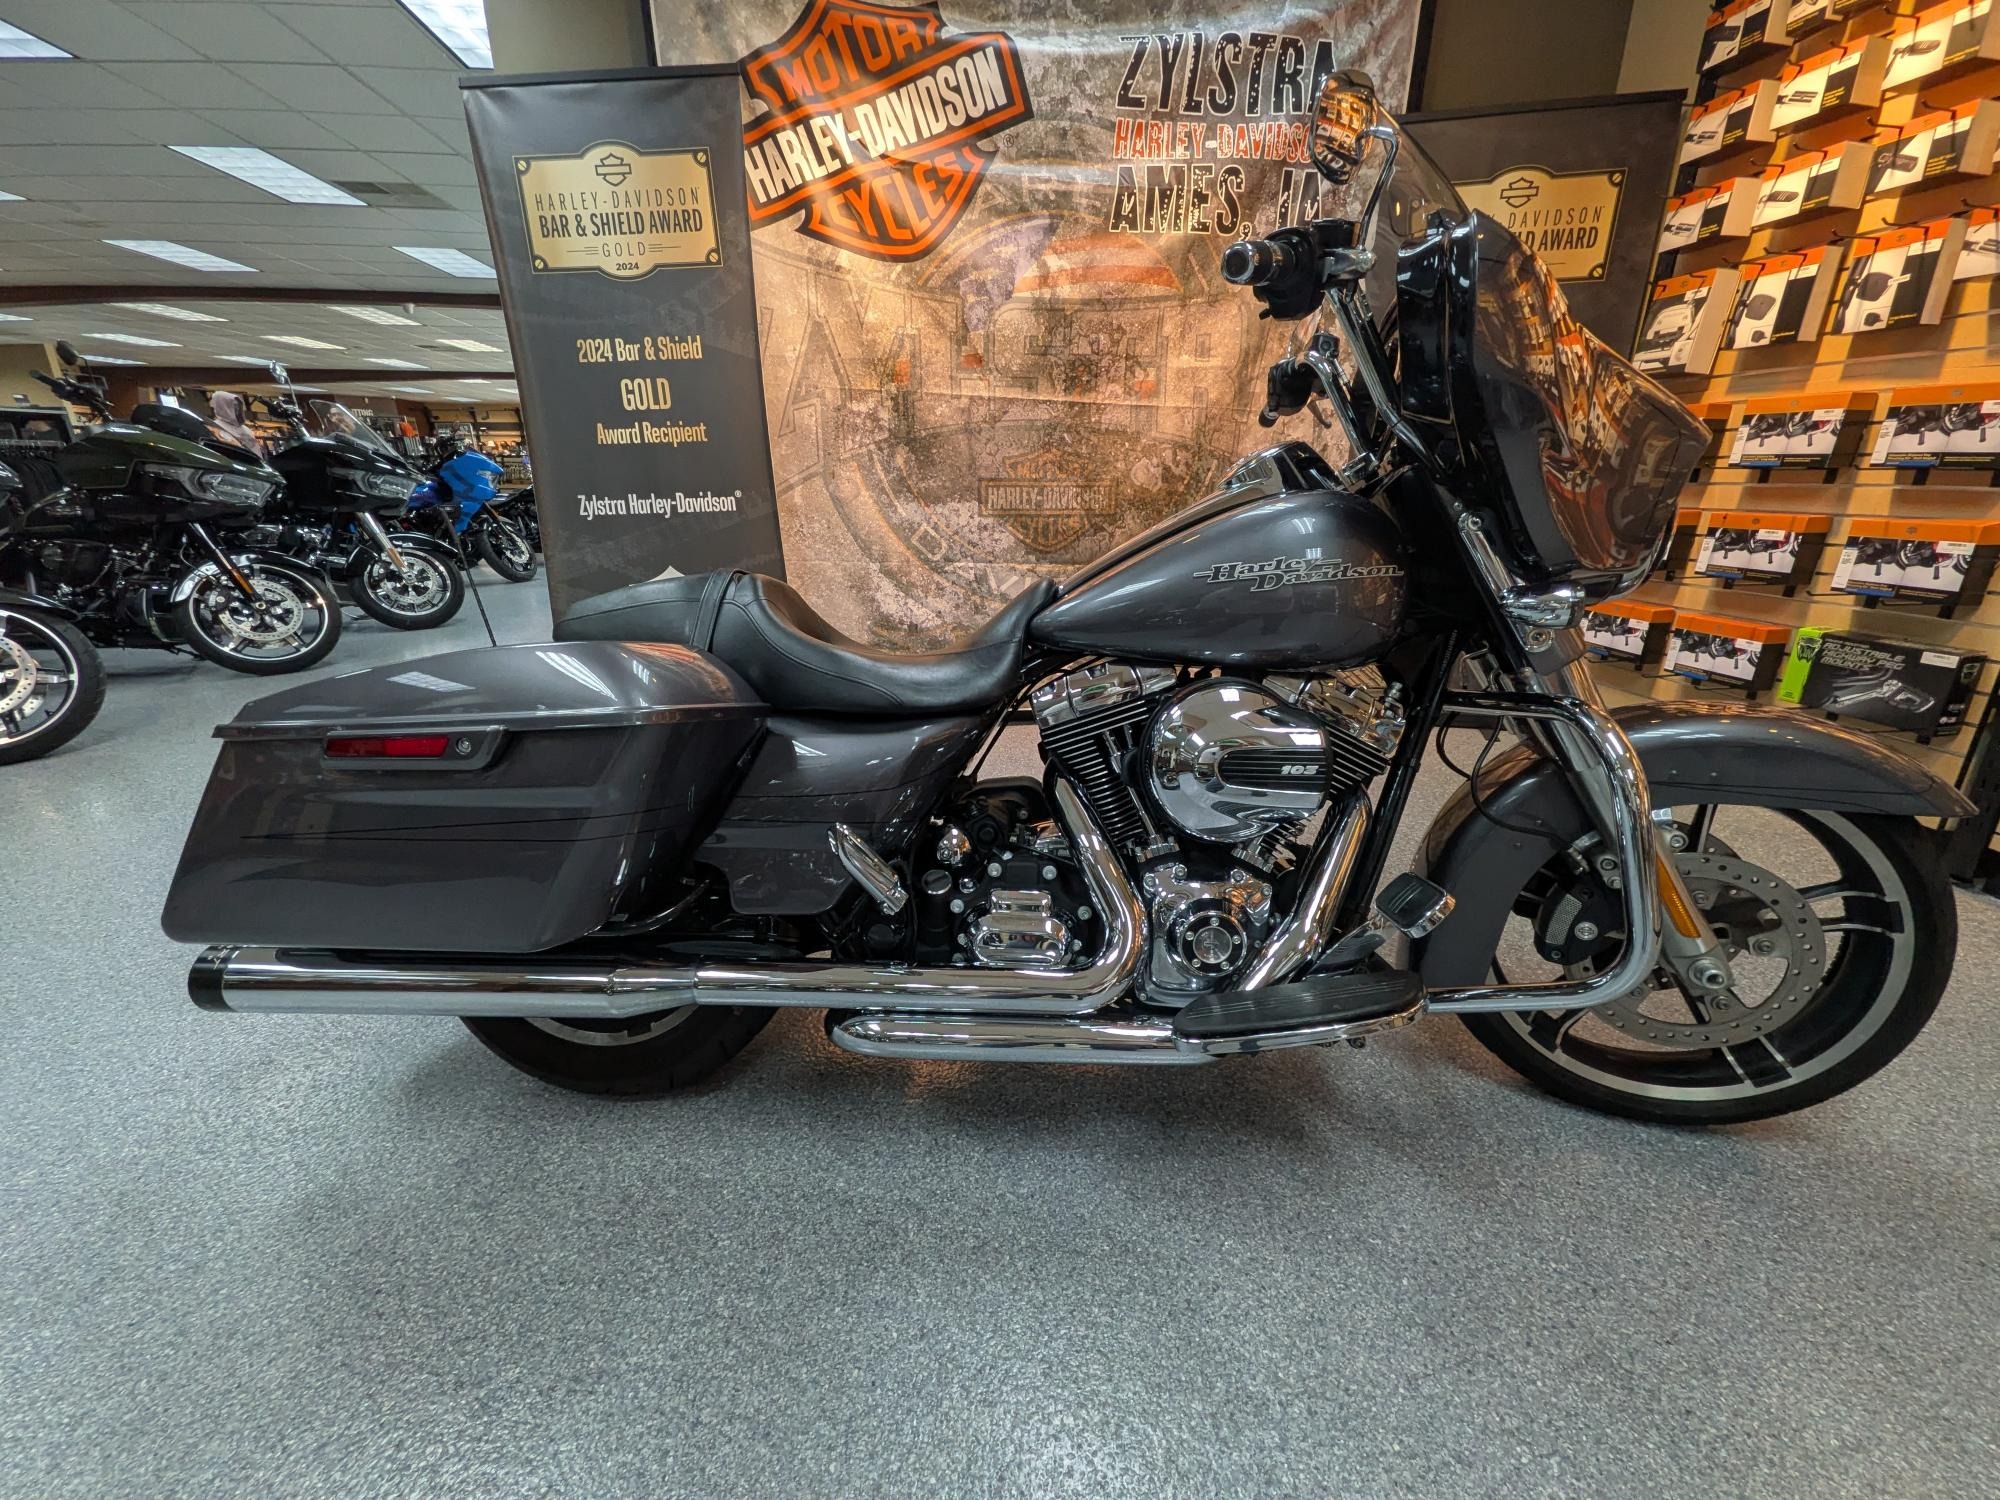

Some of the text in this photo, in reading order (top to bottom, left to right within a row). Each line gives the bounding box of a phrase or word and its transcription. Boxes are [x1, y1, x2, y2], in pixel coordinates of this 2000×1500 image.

[777, 9, 922, 101] MOTOR
[1115, 31, 1337, 117] ZYLSTRA
[744, 46, 1008, 204] HARLEY-DAVIDSON
[535, 186, 700, 212] HARLEY-DAVIDSON
[826, 151, 963, 240] CYCLES
[1108, 164, 1323, 241] AMES, IA
[538, 209, 703, 238] BAR & SHIELD AWARD
[602, 241, 646, 257] GOLD
[1539, 226, 1599, 251] AWARD
[615, 262, 639, 271] 2024
[577, 335, 703, 363] 2024 Bar & Shield
[620, 378, 672, 411] GOLD
[596, 420, 708, 448] Award Recipient
[577, 493, 627, 521] Zylstra
[1196, 556, 1340, 583] Harley
[1250, 564, 1404, 592] Davidson
[1822, 642, 1906, 662] ADJUSTABLE
[1280, 765, 1319, 775] 103
